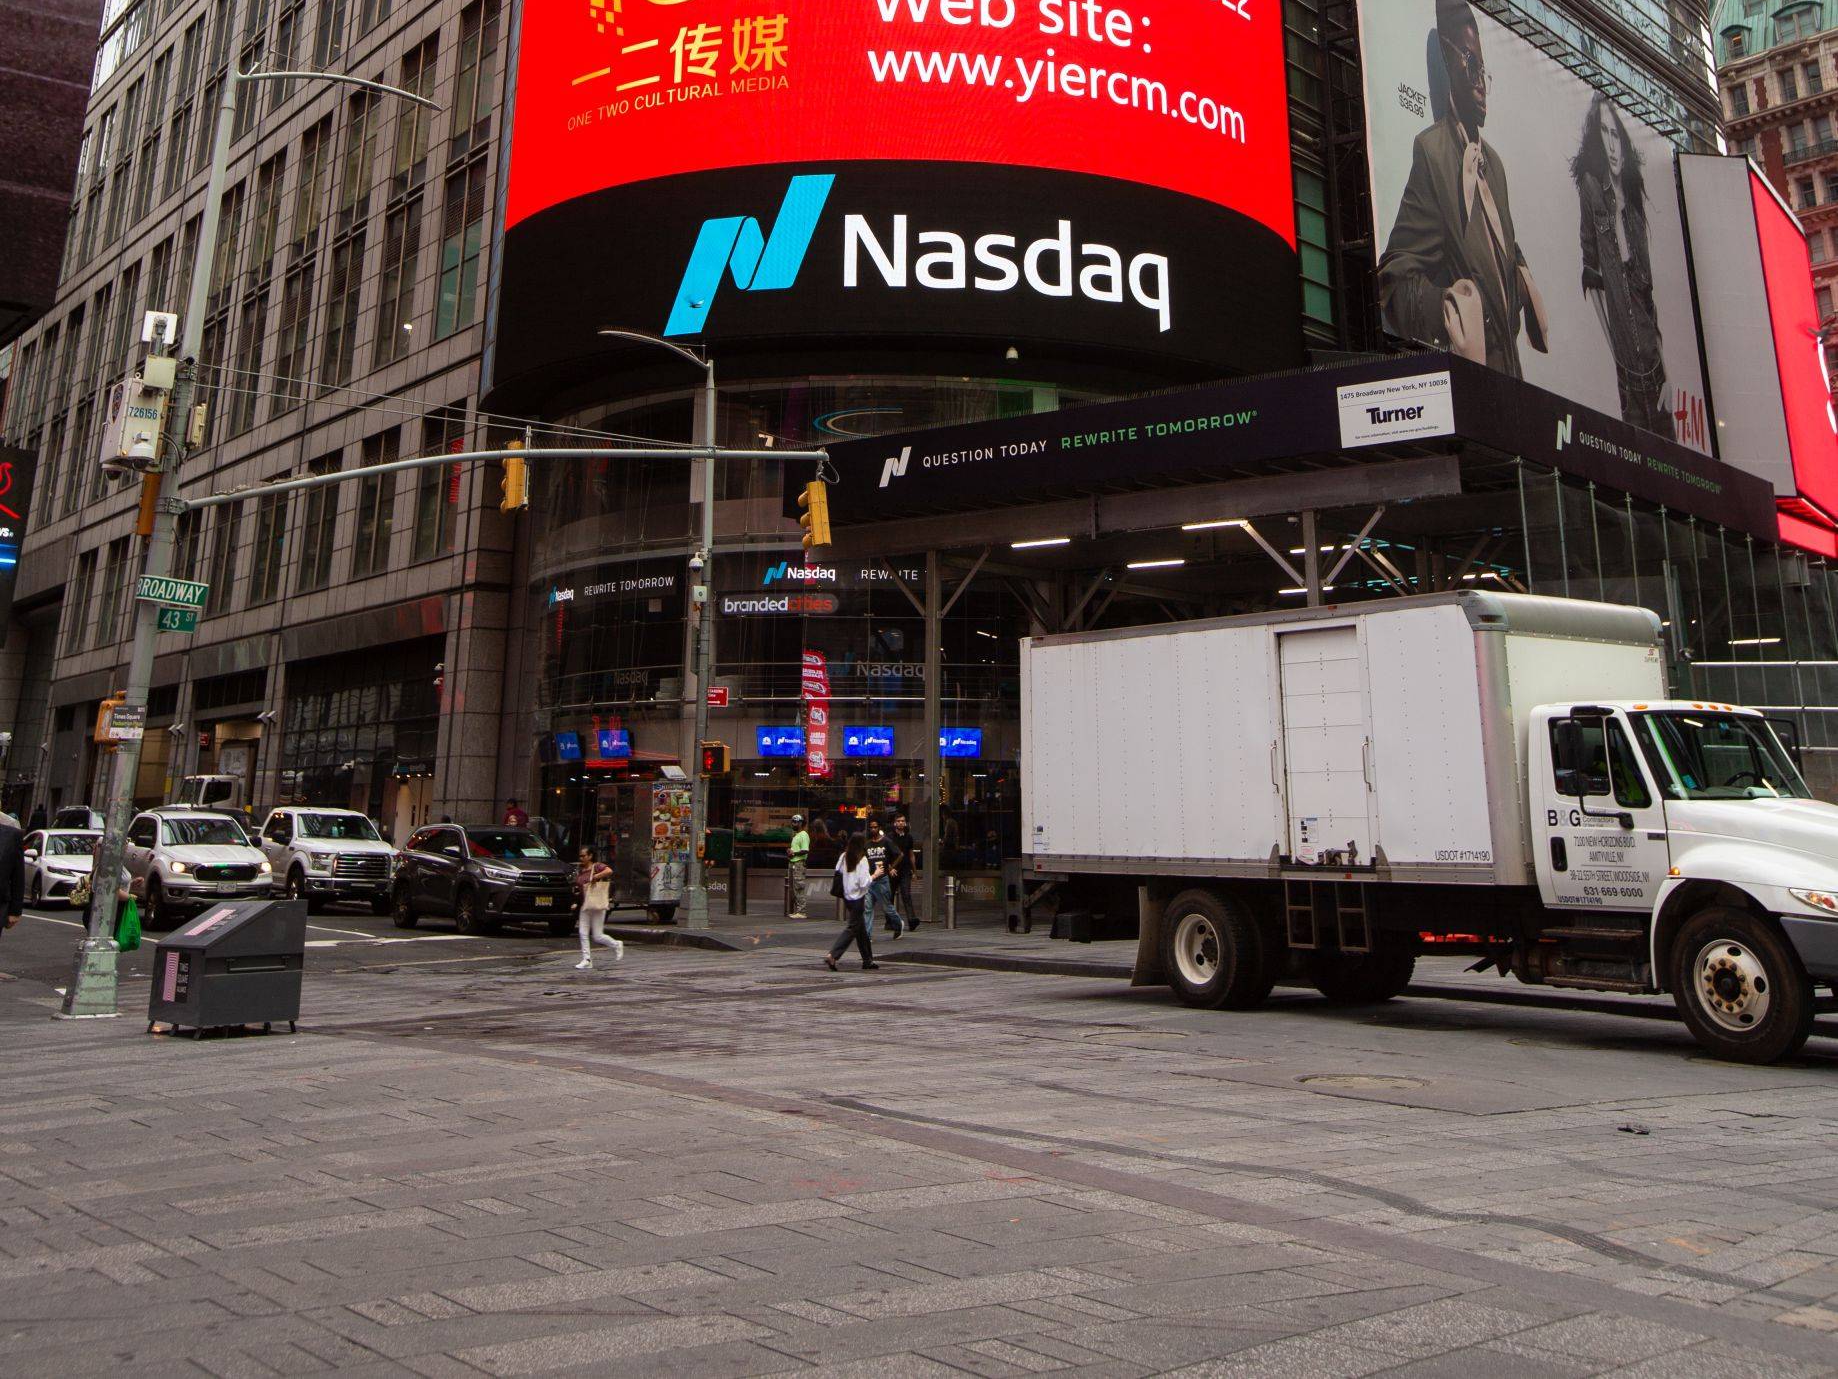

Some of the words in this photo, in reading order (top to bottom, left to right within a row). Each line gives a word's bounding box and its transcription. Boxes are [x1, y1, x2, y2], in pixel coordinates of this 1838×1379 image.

[572, 13, 789, 92] 一二传媒
[567, 110, 593, 131] ONE
[597, 100, 629, 120] TWO
[634, 82, 723, 111] CULTURAL
[730, 75, 789, 94] MEDIA
[867, 48, 1246, 144] www.yiercm.com
[1397, 82, 1427, 107] JACKET
[843, 214, 1171, 333] Nasdaq
[1355, 389, 1385, 398] Broadway
[1401, 383, 1417, 391] York,
[1429, 379, 1448, 388] 10036
[129, 406, 158, 421] 726156
[1366, 405, 1424, 425] Turner
[1674, 387, 1706, 452] H&M
[923, 448, 993, 468] QUESTION
[1000, 440, 1047, 458] TODAY
[1061, 427, 1137, 449] REWRITE
[1579, 431, 1617, 456] QUESTION
[1619, 447, 1642, 465] TODAY
[1647, 457, 1680, 479] REWRITE
[787, 566, 836, 582] Nasdaq
[861, 569, 918, 581] REWITE
[136, 578, 205, 604] BROADWAY
[555, 588, 574, 601] Nasdaq
[584, 581, 617, 596] REWRITE
[620, 576, 675, 591] TOMORROW
[724, 596, 833, 613] brandedcities
[162, 611, 180, 629] 43
[185, 612, 195, 622] ST
[614, 670, 649, 687] Nasdaq
[856, 660, 926, 682] Nasdaq
[1435, 850, 1459, 861] USDOT
[960, 883, 995, 895] Nasdaq
